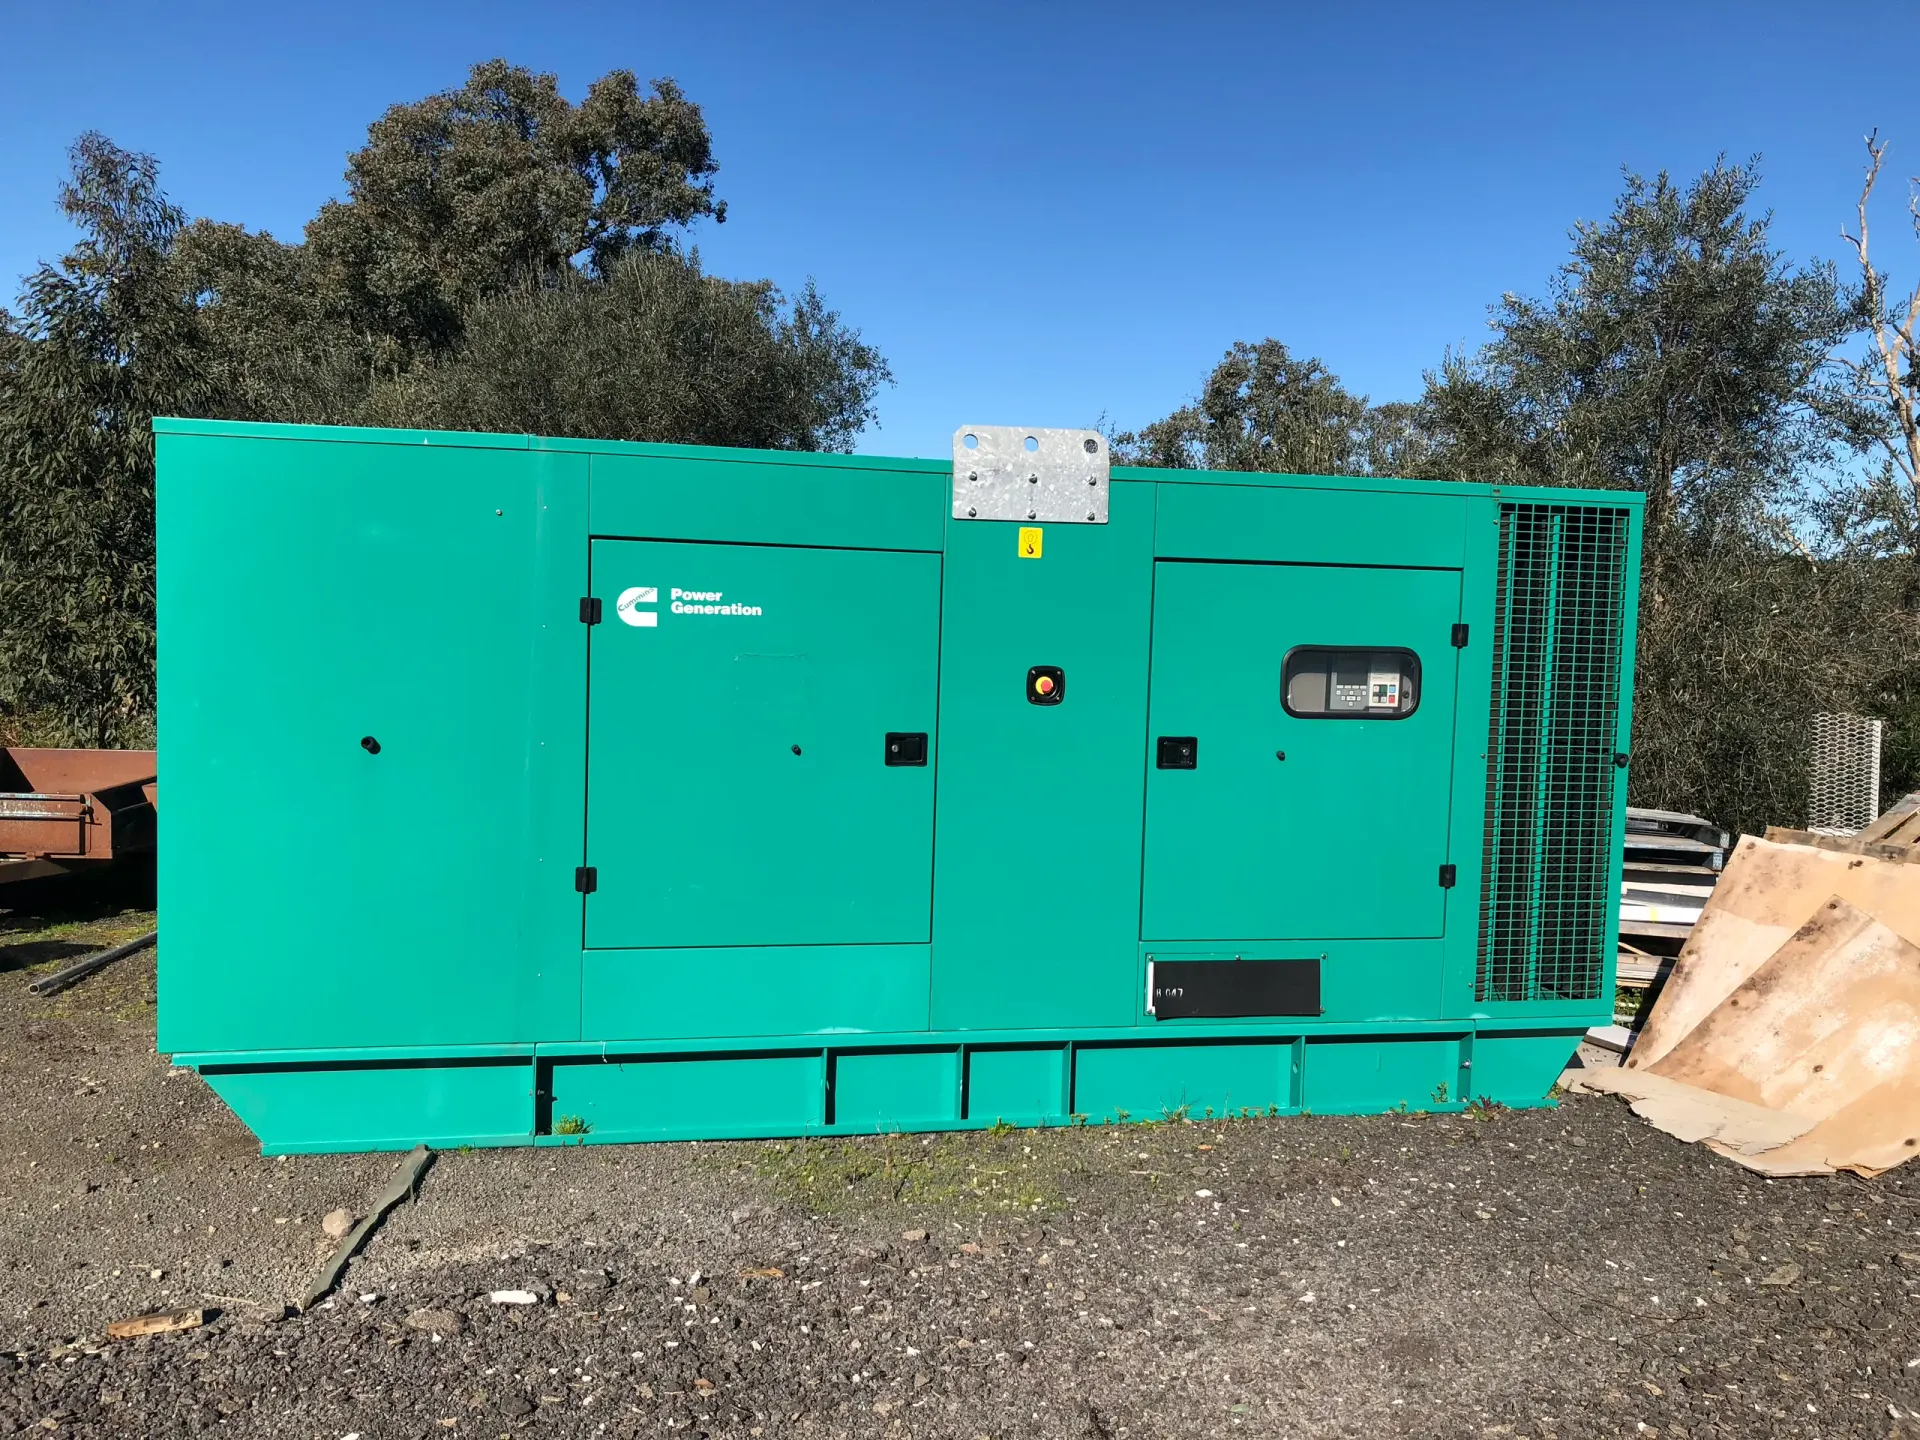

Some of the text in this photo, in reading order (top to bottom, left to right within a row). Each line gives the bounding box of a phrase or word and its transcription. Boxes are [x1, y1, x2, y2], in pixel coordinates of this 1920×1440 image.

[617, 587, 655, 612] Cummins
[671, 588, 723, 601] Power
[671, 601, 762, 616] Generation
